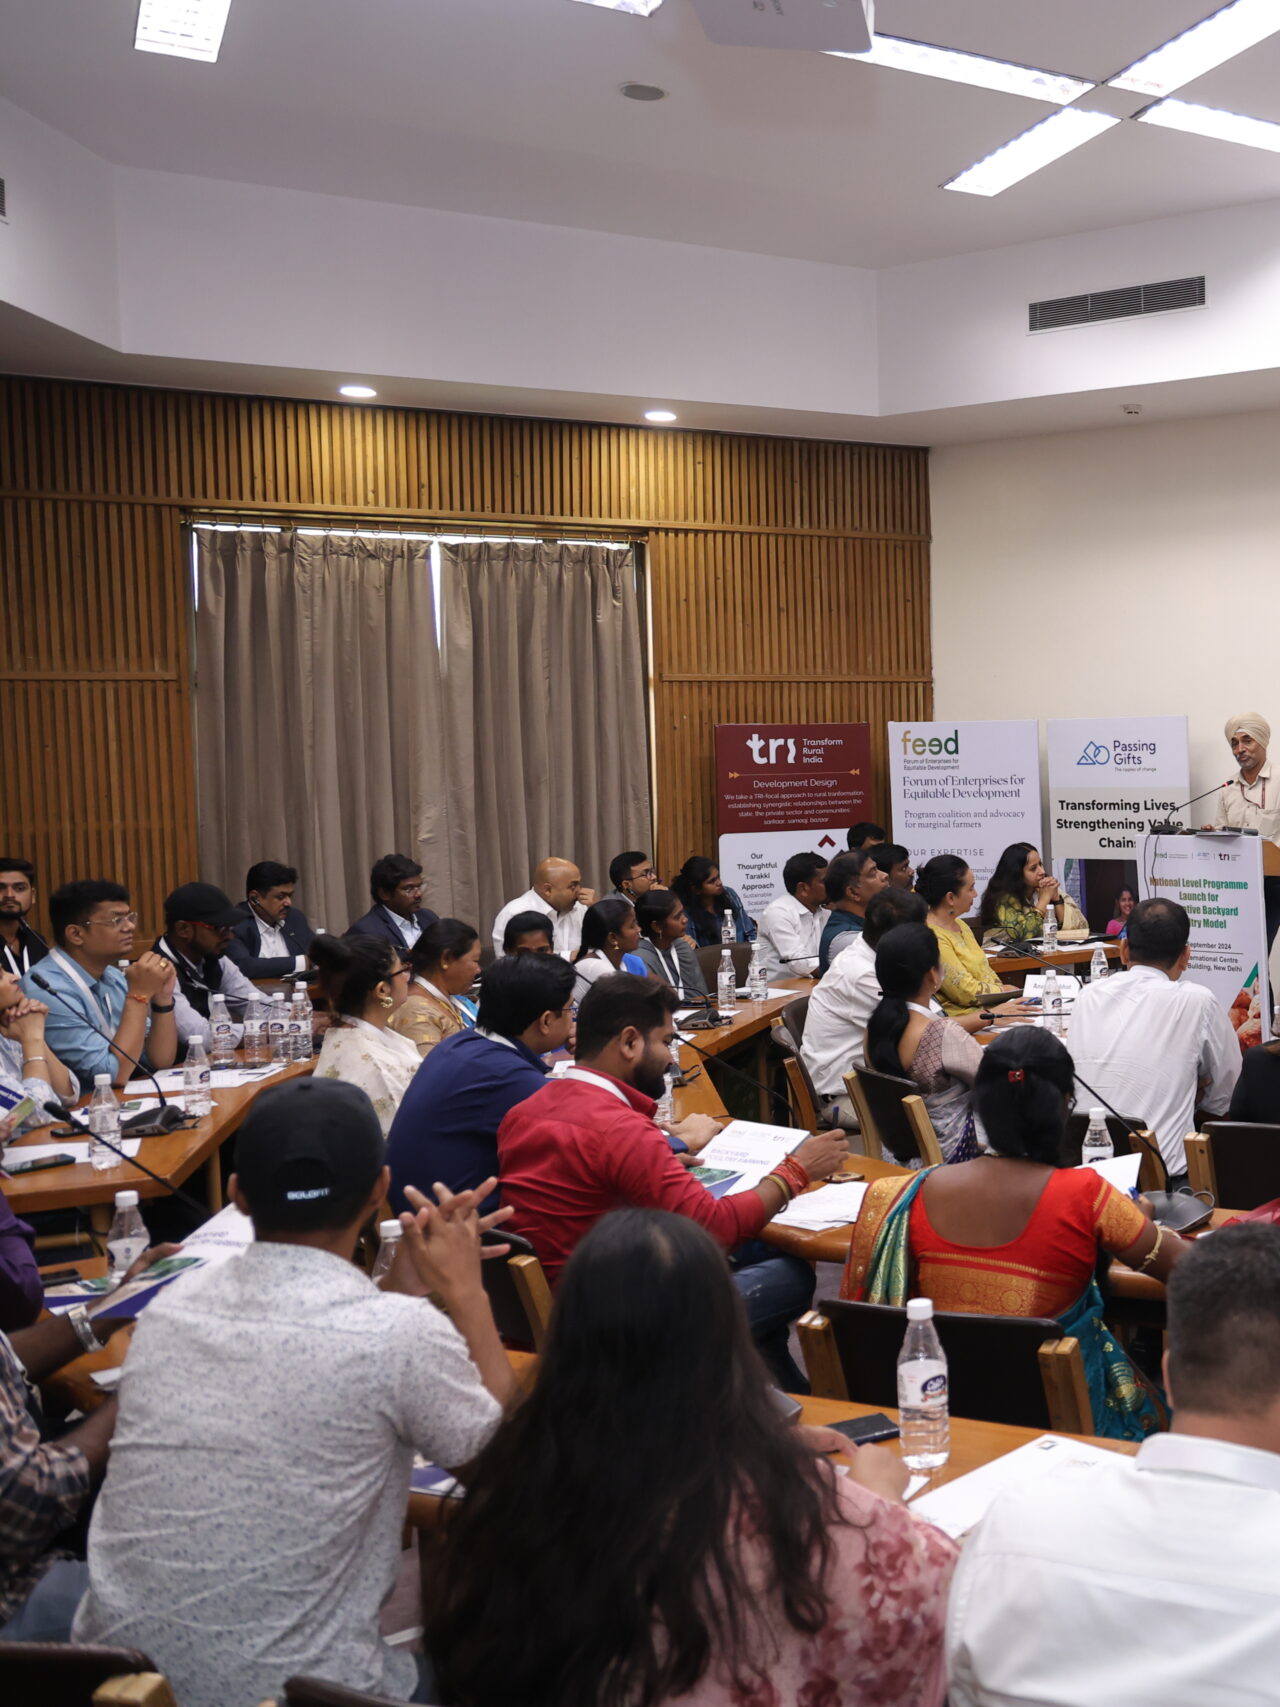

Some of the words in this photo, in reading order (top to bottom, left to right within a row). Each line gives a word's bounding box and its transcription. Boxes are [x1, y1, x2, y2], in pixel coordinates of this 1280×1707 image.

[802, 738, 844, 746] Transform
[1113, 740, 1156, 755] Passing
[802, 756, 823, 764] India
[1113, 753, 1142, 765] Gifts
[753, 779, 808, 790] Development
[810, 778, 838, 788] Design
[902, 776, 937, 786] Forum
[938, 774, 951, 786] of
[952, 774, 1008, 788] Enterprises
[1010, 774, 1026, 785] for
[903, 788, 951, 800] Equitable
[952, 788, 1020, 800] Development
[1058, 798, 1140, 813] Transforming
[904, 810, 936, 820] Program
[938, 809, 972, 818] coalition
[973, 809, 988, 818] and
[989, 809, 1026, 819] advocacy
[904, 820, 916, 828] for
[918, 820, 951, 830] marginal
[952, 820, 982, 828] farmers
[1056, 818, 1144, 832] Strengthening
[930, 848, 985, 856] EXPERTISE
[737, 862, 778, 871] Thourghtful
[742, 883, 774, 891] Approach
[1150, 877, 1180, 887] National
[1182, 878, 1202, 888] Level
[1203, 880, 1248, 890] Programme
[1179, 892, 1206, 901] Launch
[1208, 892, 1219, 902] for
[1202, 905, 1239, 916] Backyard
[1203, 919, 1227, 929] Model
[1220, 956, 1238, 964] Centre
[1188, 962, 1212, 972] Building,
[1214, 963, 1227, 971] New
[1228, 964, 1242, 972] Delhi
